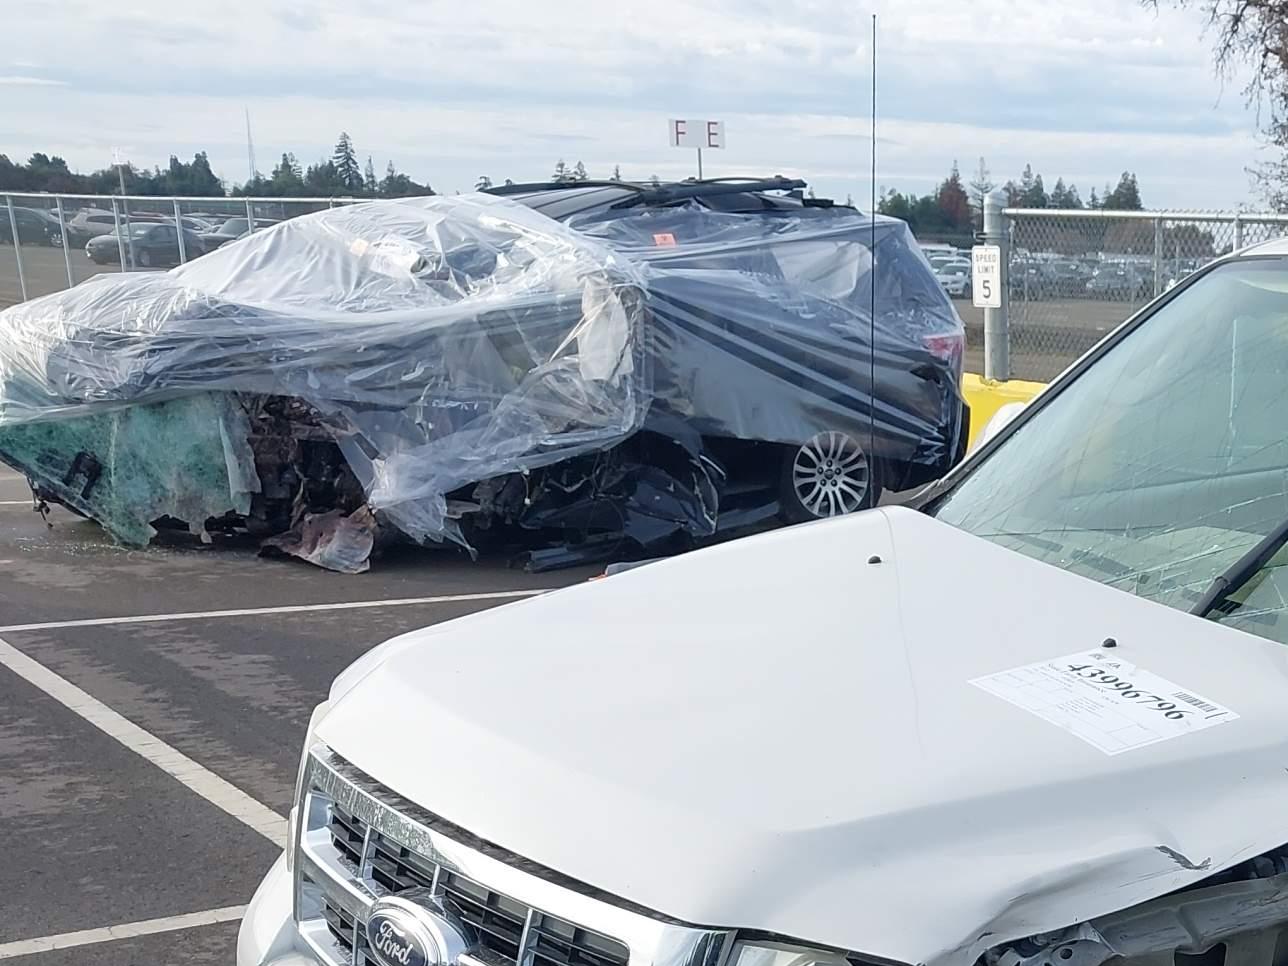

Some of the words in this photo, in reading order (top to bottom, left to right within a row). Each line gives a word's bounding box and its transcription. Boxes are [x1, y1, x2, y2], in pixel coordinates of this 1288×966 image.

[675, 120, 686, 146] F
[707, 121, 719, 148] E
[975, 254, 997, 263] SPEED
[977, 265, 995, 274] LIMIT
[982, 279, 991, 299] 5
[1066, 663, 1196, 720] 43996796
[375, 920, 414, 966] Ford
